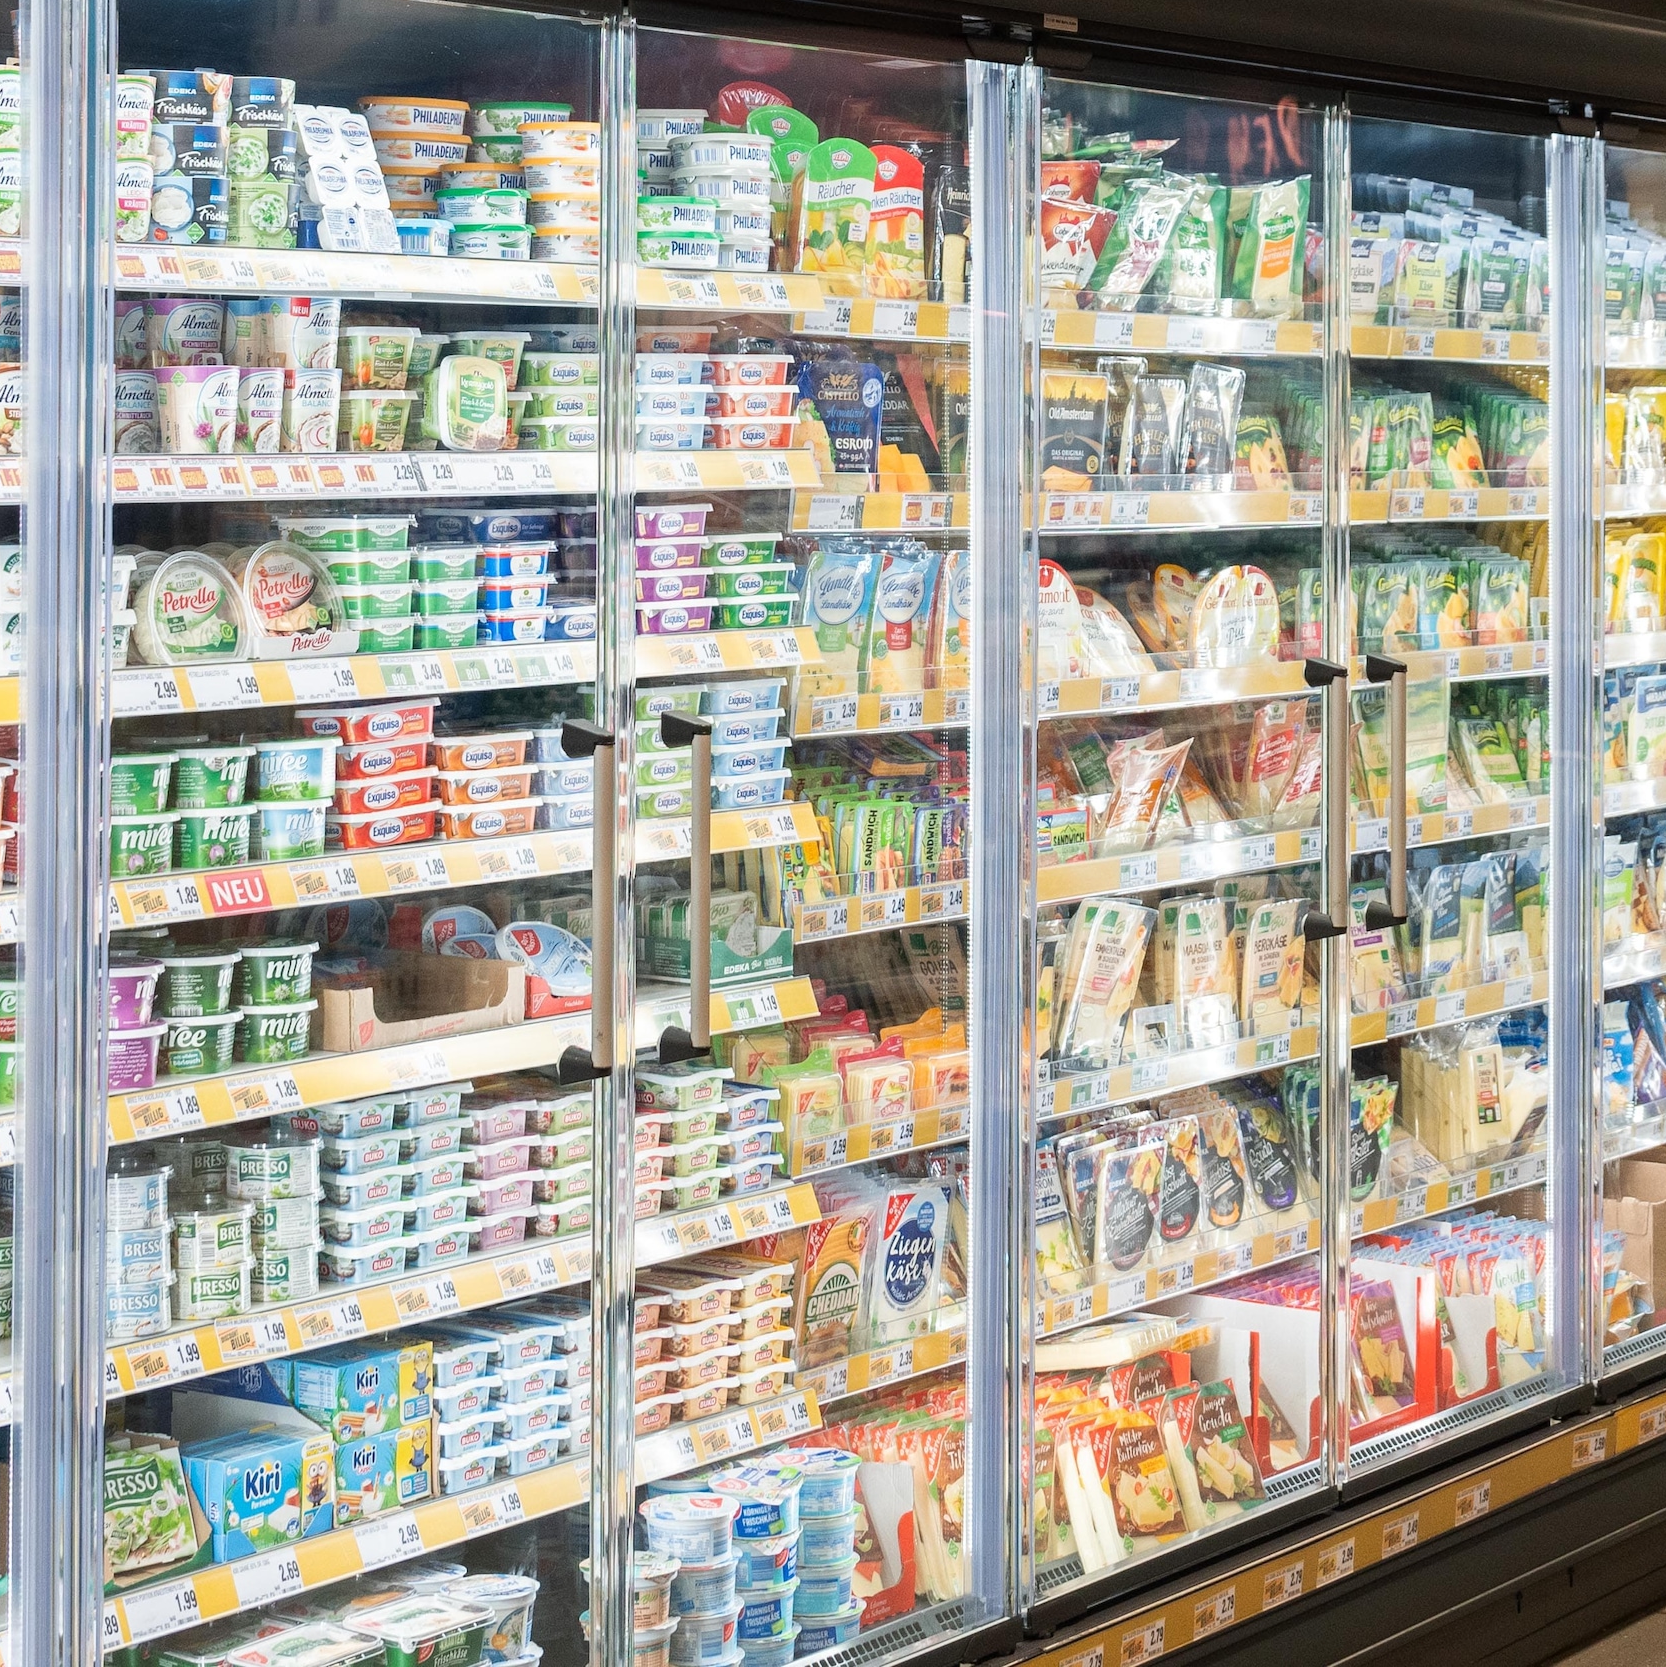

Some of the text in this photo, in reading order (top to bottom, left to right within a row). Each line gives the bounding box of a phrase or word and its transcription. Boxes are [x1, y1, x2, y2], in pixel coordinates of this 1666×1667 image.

[154, 97, 207, 116] Frischkäse
[817, 182, 856, 199] Räucher
[836, 307, 851, 322] 2.99
[817, 390, 860, 401] CASTELLO
[258, 572, 315, 599] Petrella
[162, 588, 220, 614] Petrella
[291, 631, 333, 652] Petrella
[422, 663, 442, 681] 3.49
[371, 819, 402, 839] Exquisa
[864, 808, 877, 866] SANDWICH
[210, 877, 266, 906] NEU
[361, 1114, 383, 1128] BUKO
[239, 1157, 289, 1177] BRESSO
[806, 1286, 859, 1316] CHEDDAR
[355, 1367, 379, 1389] Kiri
[1199, 1411, 1232, 1432] Gouda
[244, 1460, 282, 1500] Kiri
[742, 1512, 778, 1525] FRISCHKÄSE
[278, 1561, 300, 1582] 2.69
[1290, 1569, 1303, 1586] 2.79
